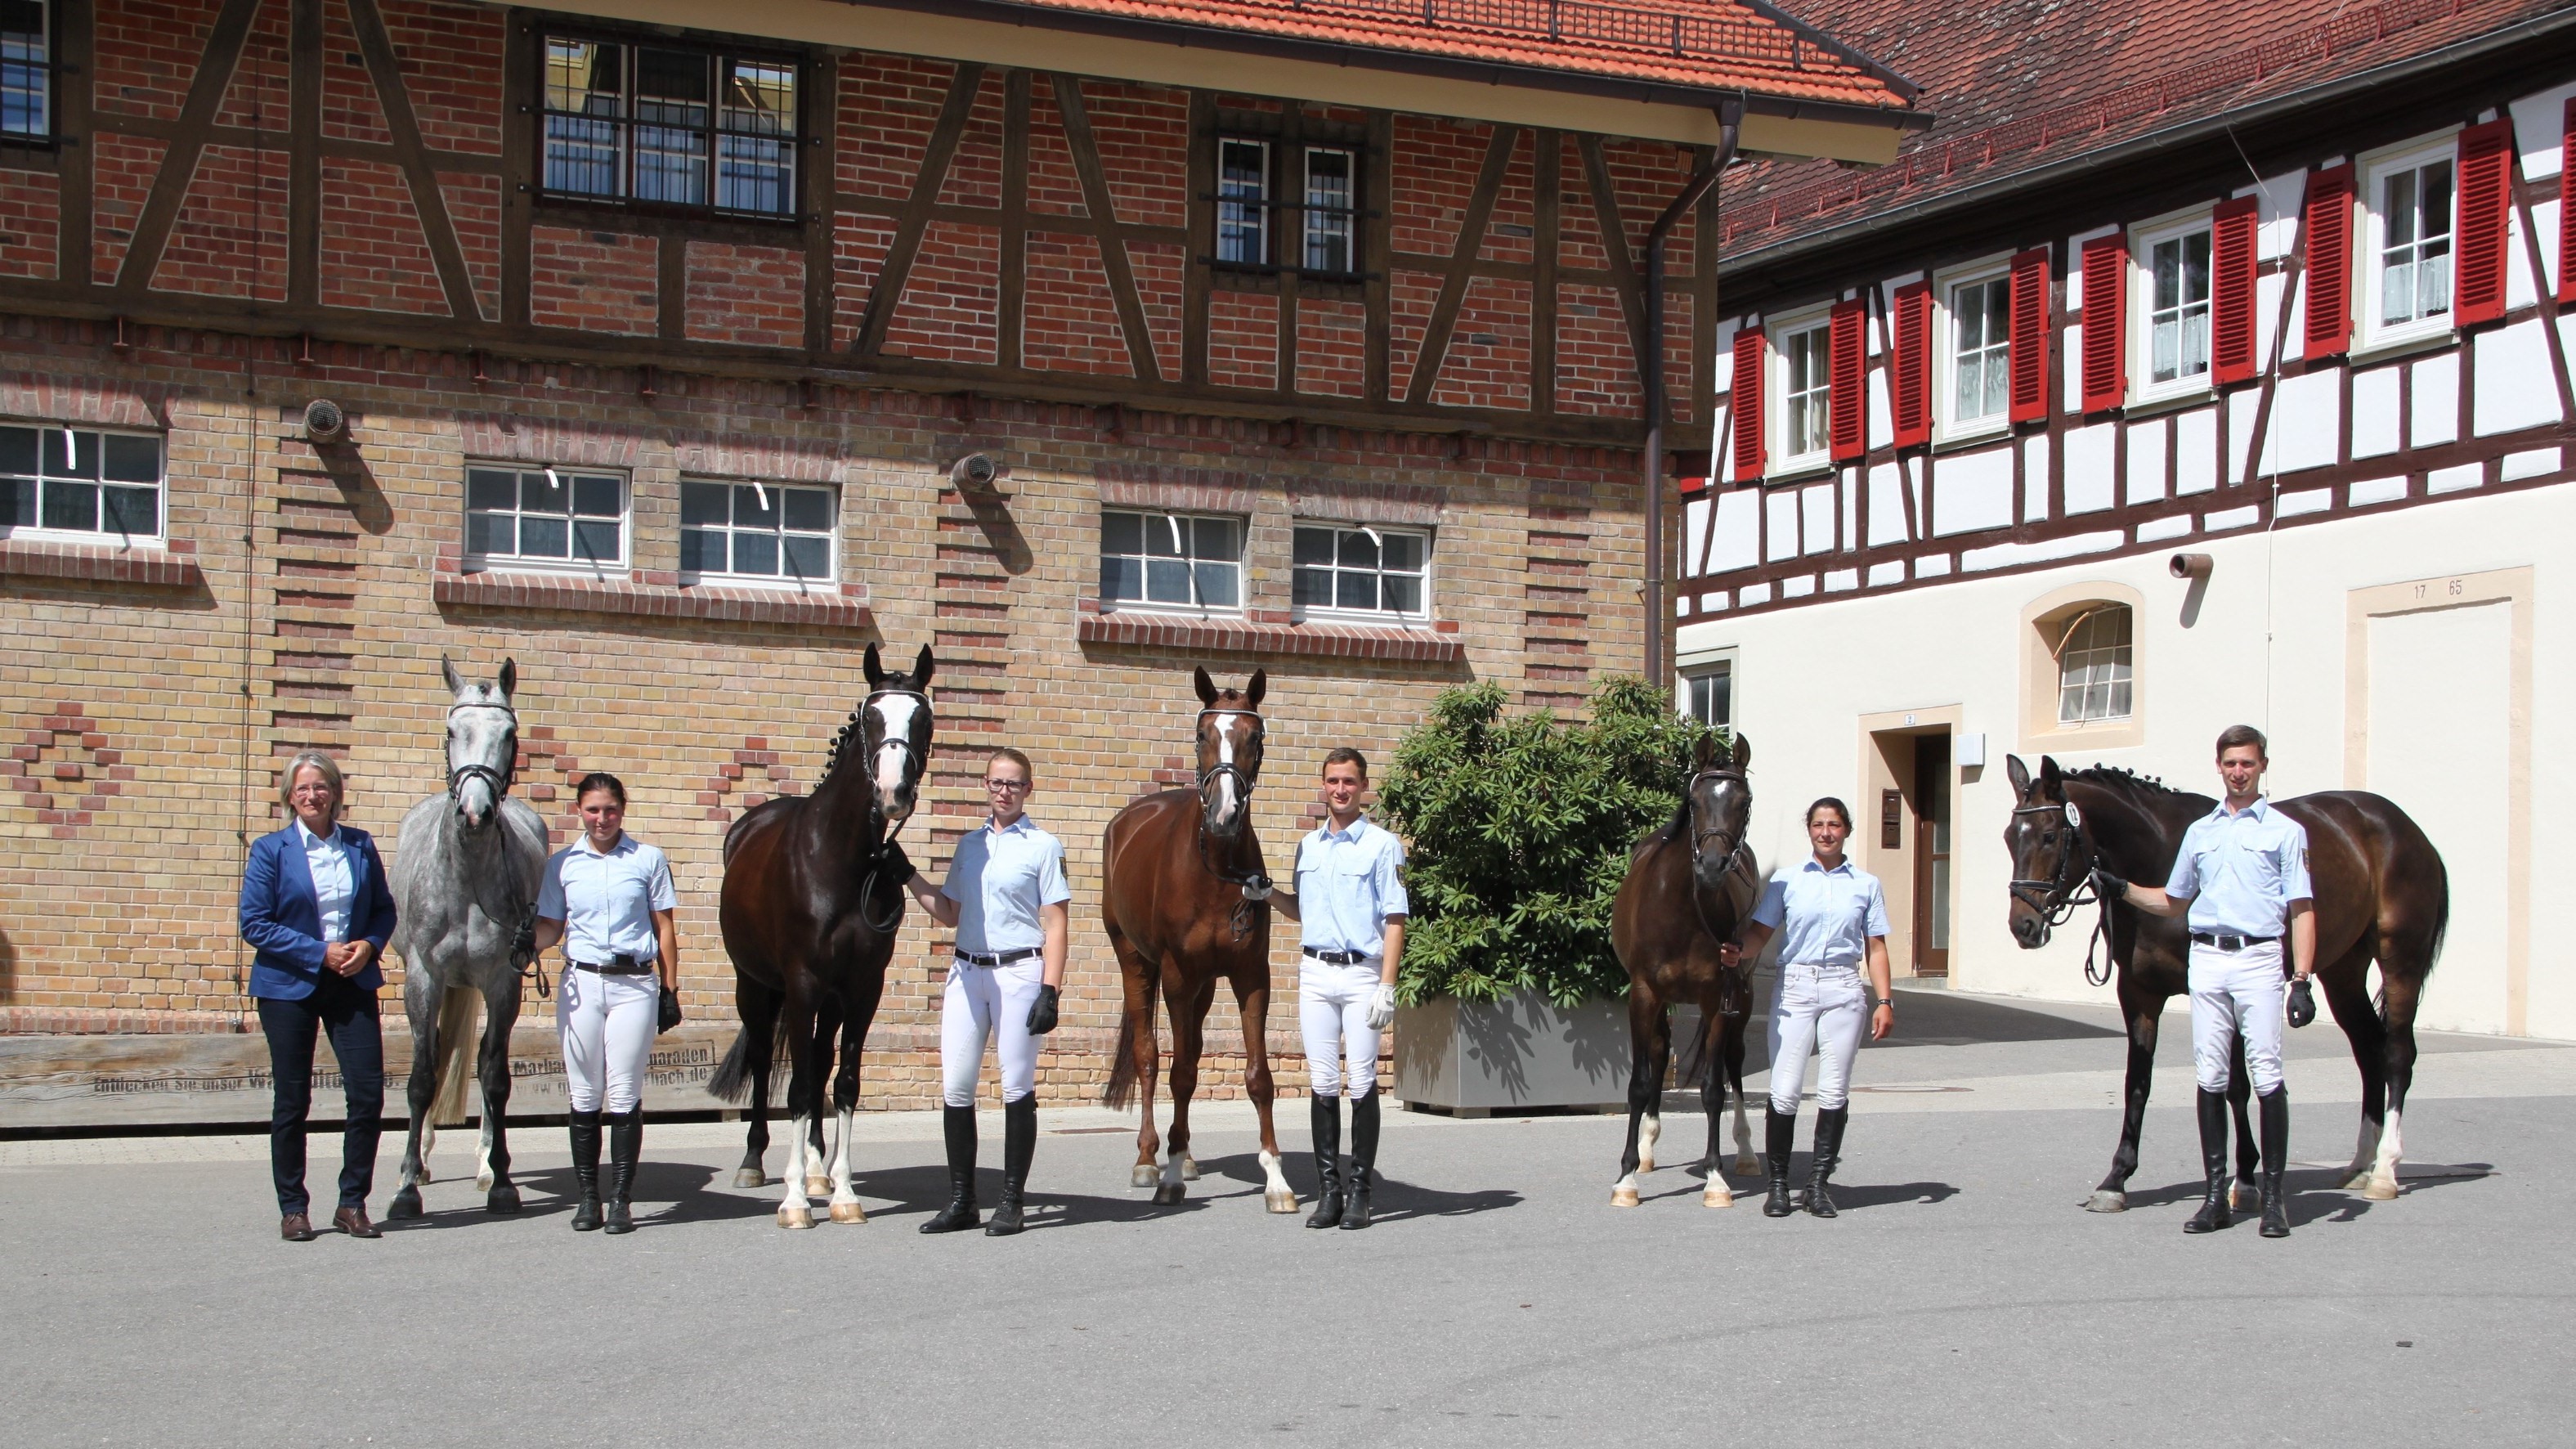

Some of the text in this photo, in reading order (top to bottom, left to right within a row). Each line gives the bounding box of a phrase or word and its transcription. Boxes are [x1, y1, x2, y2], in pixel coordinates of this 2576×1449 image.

[2415, 580, 2462, 599] 17 65
[648, 1048, 708, 1070] paraden
[94, 1077, 168, 1092] Entdecken
[174, 1079, 197, 1091] Sie
[202, 1078, 243, 1091] unser
